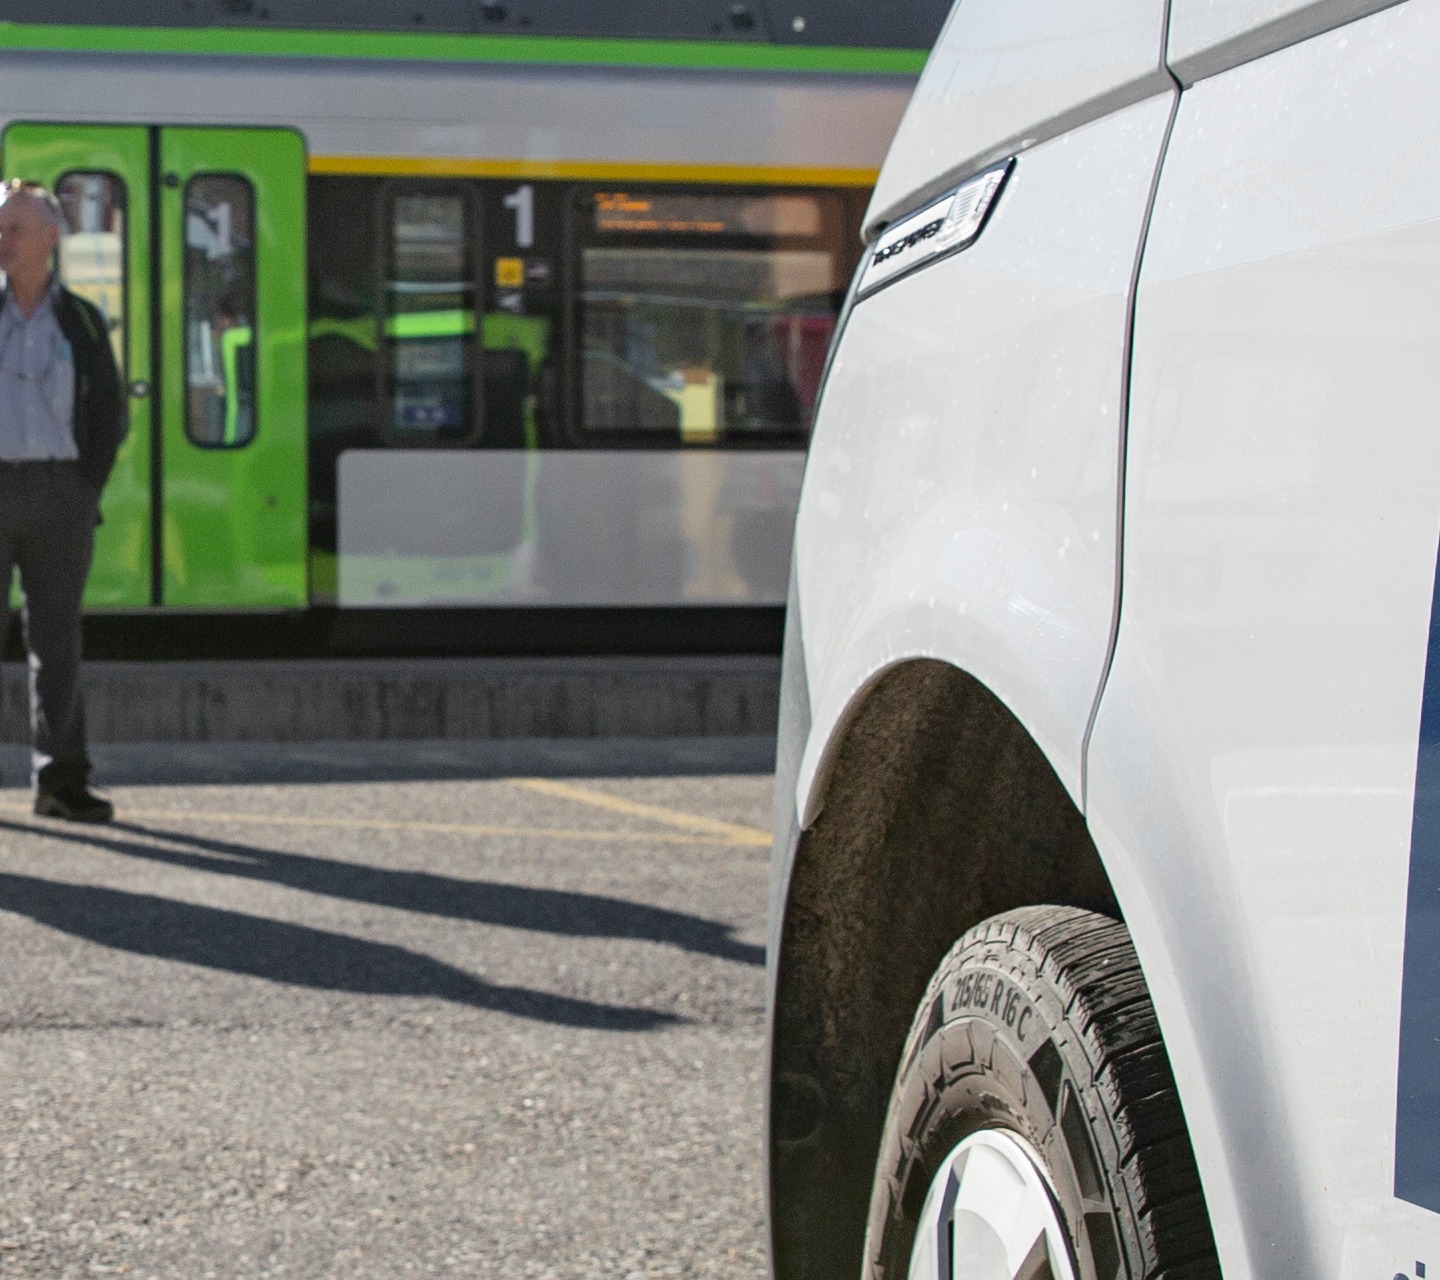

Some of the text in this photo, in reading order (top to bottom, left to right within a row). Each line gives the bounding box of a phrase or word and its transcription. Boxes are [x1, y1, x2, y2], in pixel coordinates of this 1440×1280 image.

[504, 185, 534, 248] 1
[951, 972, 1033, 1042] 215/65 R 16 C
